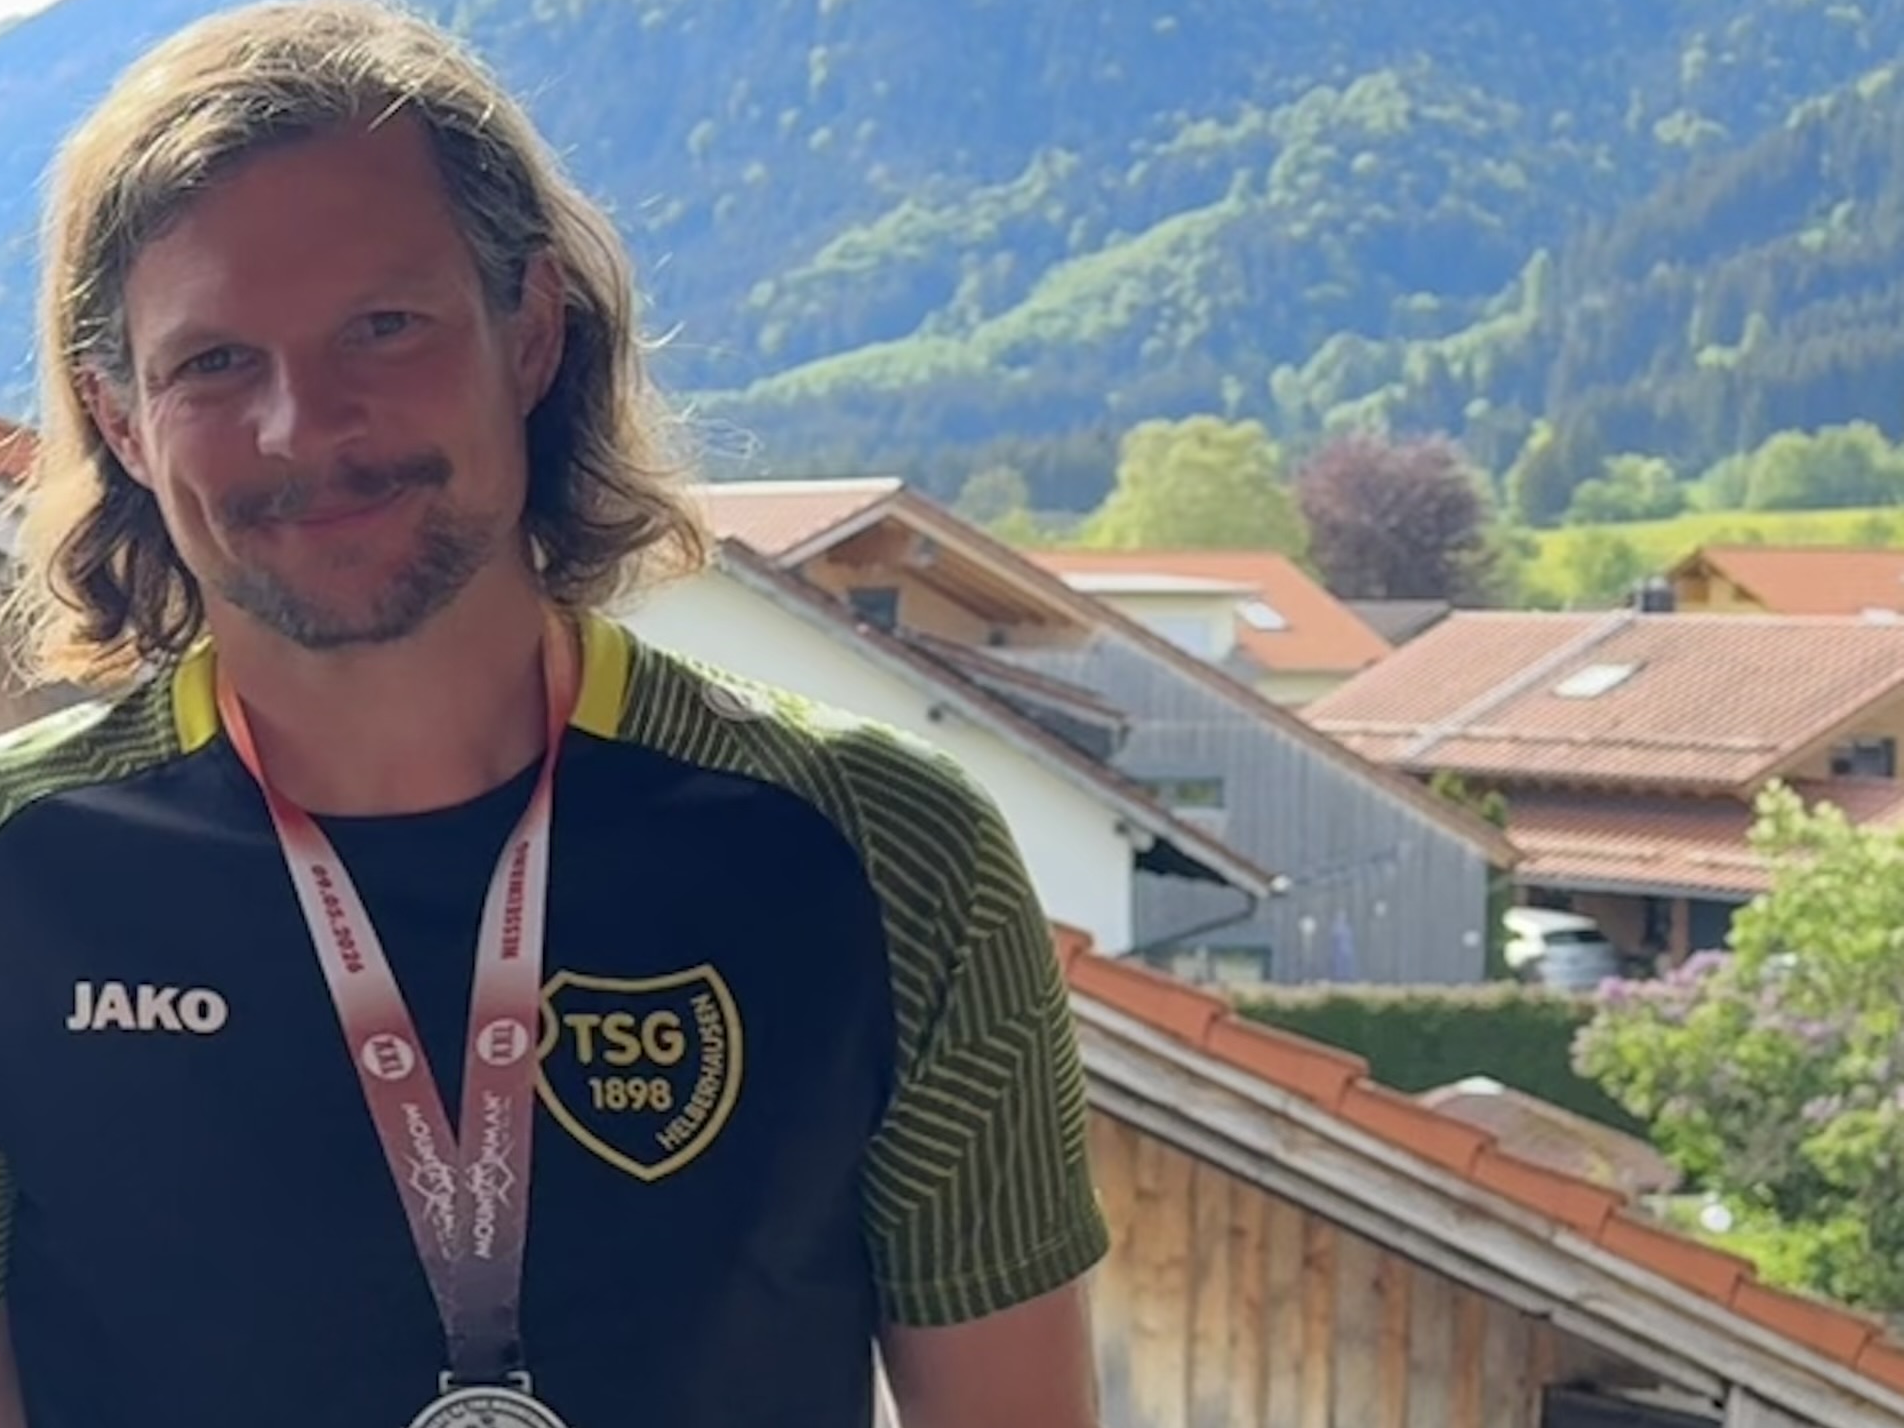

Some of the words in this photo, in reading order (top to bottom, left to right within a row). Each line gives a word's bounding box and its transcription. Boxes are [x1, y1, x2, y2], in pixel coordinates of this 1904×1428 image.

[66, 980, 228, 1034] JAKO
[563, 1010, 685, 1066] TSG
[588, 1076, 674, 1112] 1898
